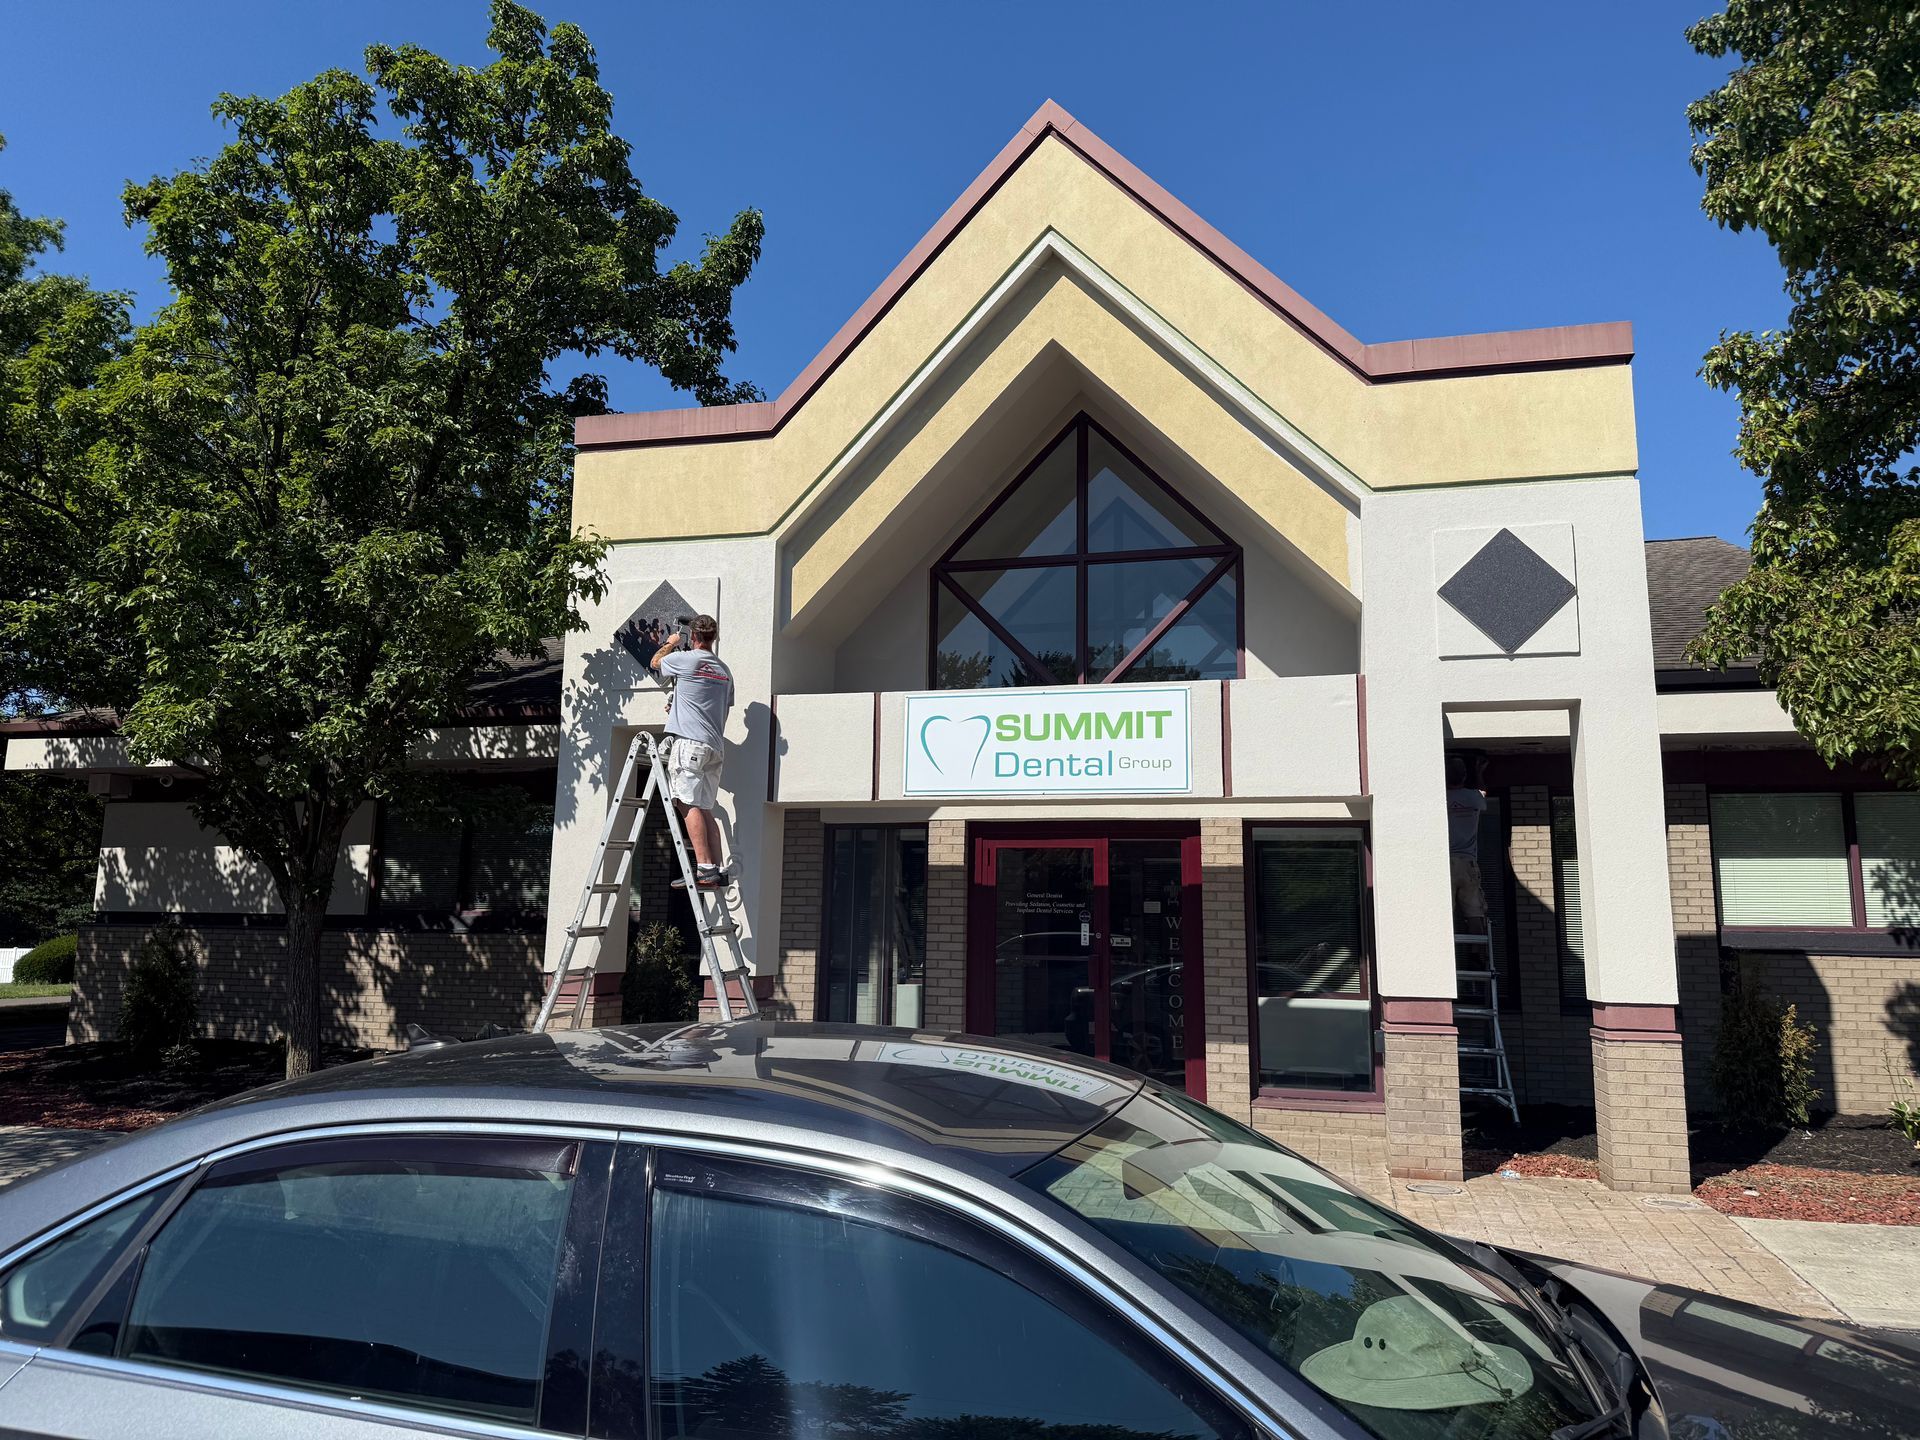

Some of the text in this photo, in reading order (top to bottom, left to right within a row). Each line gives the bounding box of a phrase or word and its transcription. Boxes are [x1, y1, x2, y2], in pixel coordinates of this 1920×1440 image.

[995, 710, 1172, 741] SUMMIT
[994, 750, 1172, 777] Dental Group
[1165, 916, 1184, 1049] WELCOME
